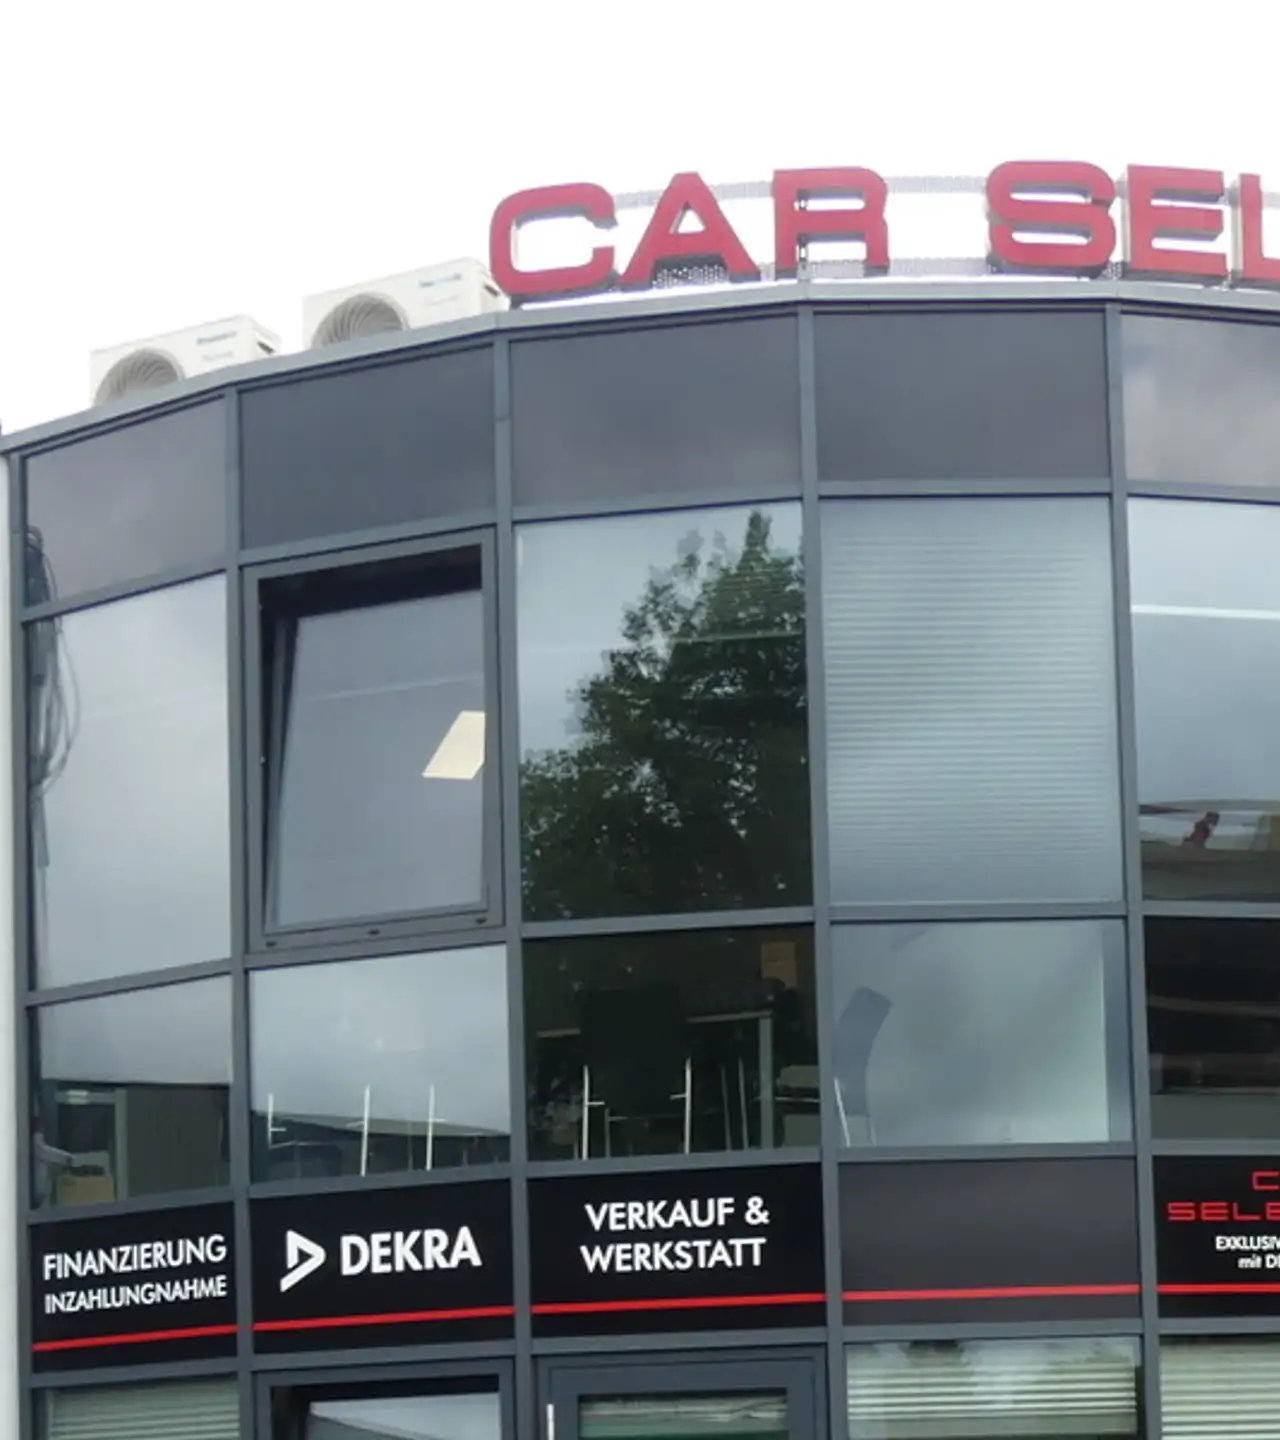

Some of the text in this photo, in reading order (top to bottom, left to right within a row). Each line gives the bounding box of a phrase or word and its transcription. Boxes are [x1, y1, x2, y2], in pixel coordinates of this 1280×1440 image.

[489, 166, 890, 298] CAR
[584, 1195, 770, 1232] VERKAUF &
[43, 1234, 227, 1281] FINANZIERUNG
[340, 1225, 483, 1277] DEKRA
[579, 1237, 768, 1274] WERKSTATT
[1238, 1253, 1262, 1269] mit
[44, 1273, 227, 1315] INZAHLUNGNAHME
